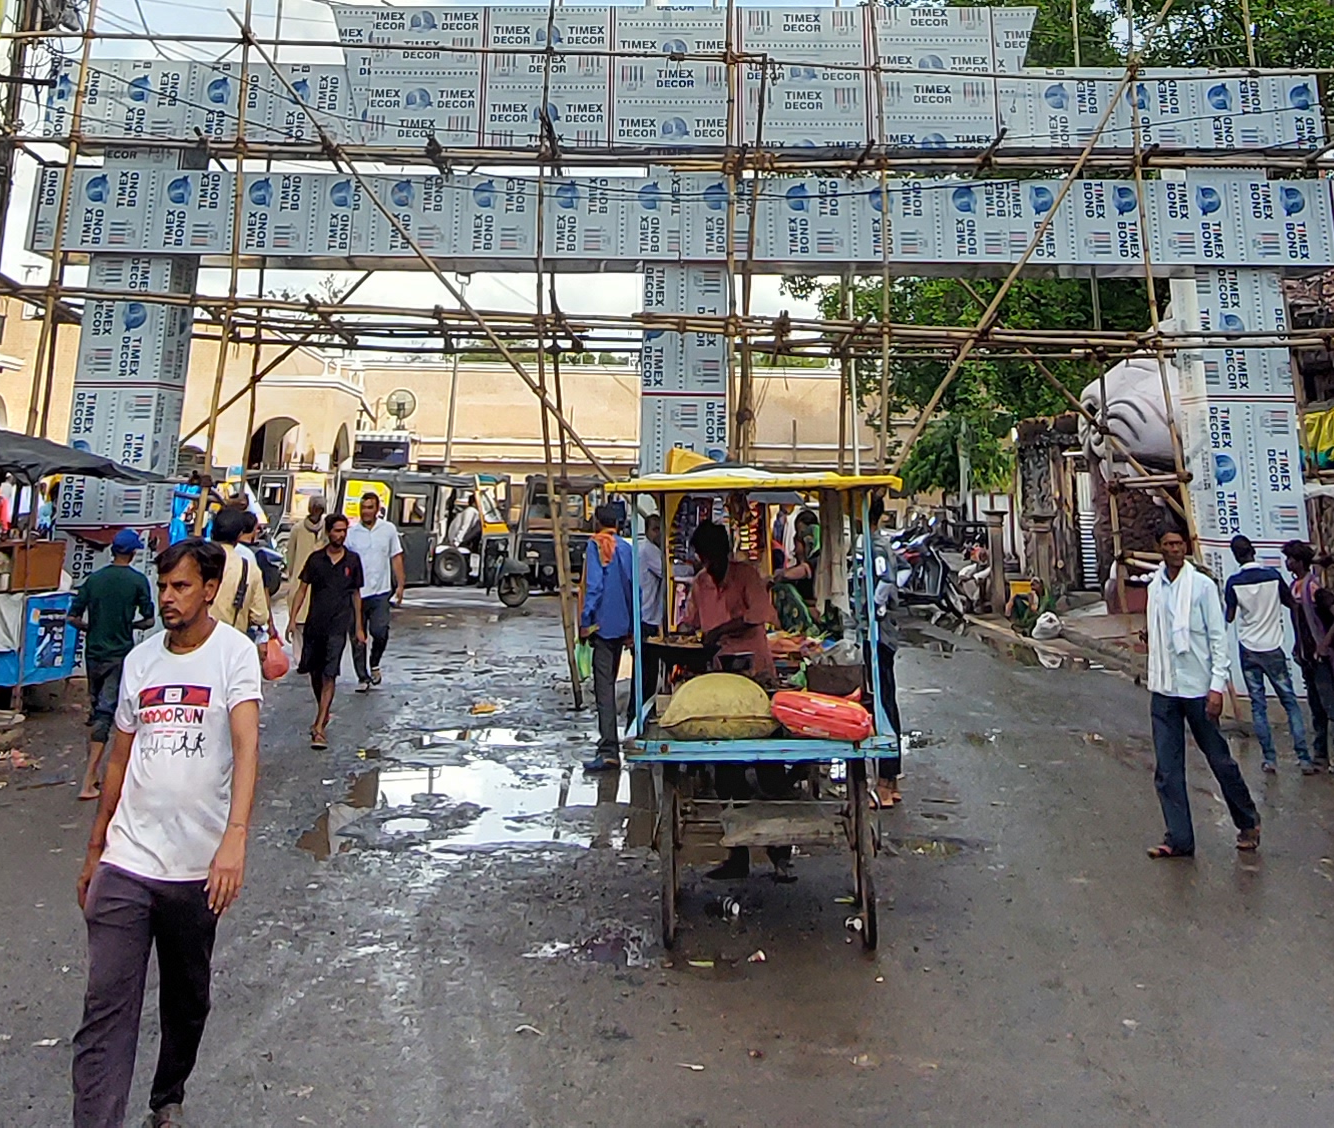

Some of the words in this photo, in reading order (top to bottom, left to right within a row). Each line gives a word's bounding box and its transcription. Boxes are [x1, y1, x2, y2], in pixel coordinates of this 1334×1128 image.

[441, 21, 479, 31] DECOR
[443, 12, 479, 21] TIMEX
[493, 25, 531, 35] TIMEX
[567, 25, 605, 35] TIMEX
[782, 23, 821, 32] DECOR
[783, 13, 821, 23] TIMEX
[910, 8, 948, 17] TIMEX
[910, 18, 949, 27] DECOR
[493, 35, 531, 45] DECOR
[567, 36, 605, 45] DECOR
[620, 39, 657, 49] TIMEX
[657, 69, 694, 78] TIMEX
[950, 56, 988, 65] TIMEX
[317, 74, 330, 111] TIMEX
[328, 76, 339, 111] BOND
[438, 89, 475, 99] TIMEX
[656, 78, 695, 88] DECOR
[784, 91, 822, 100] TIMEX
[913, 85, 951, 94] TIMEX
[913, 95, 952, 104] DECOR
[1157, 80, 1170, 116] TIMEX
[1168, 80, 1180, 114] BOND
[437, 99, 475, 108] DECOR
[490, 103, 528, 113] TIMEX
[490, 113, 528, 122] DECOR
[565, 113, 604, 123] DECOR
[566, 103, 603, 113] TIMEX
[784, 101, 823, 110] DECOR
[398, 119, 436, 129] TIMEX
[618, 118, 657, 128] TIMEX
[618, 128, 657, 138] DECOR
[117, 170, 130, 207] TIMEX
[128, 172, 139, 207] BOND
[198, 172, 210, 209] TIMEX
[209, 174, 220, 209] BOND
[279, 174, 292, 212] TIMEX
[291, 175, 302, 211] BOND
[423, 175, 434, 213] TIMEX
[433, 177, 444, 212] BOND
[505, 178, 517, 214] TIMEX
[516, 179, 526, 213] BOND
[1012, 181, 1024, 219] TIMEX
[1083, 182, 1095, 219] BOND
[1094, 181, 1106, 219] TIMEX
[1167, 182, 1179, 219] BOND
[1177, 181, 1189, 220] TIMEX
[1250, 183, 1262, 219] BOND
[1260, 182, 1274, 220] TIMEX
[80, 207, 93, 245] TIMEX
[91, 208, 105, 245] BOND
[328, 212, 340, 251] TIMEX
[338, 213, 350, 251] BOND
[472, 213, 484, 251] TIMEX
[483, 214, 494, 251] BOND
[555, 214, 567, 253] TIMEX
[567, 215, 577, 252] BOND
[639, 215, 650, 254] TIMEX
[650, 216, 660, 253] BOND
[704, 216, 715, 255] TIMEX
[715, 217, 725, 254] BOND
[788, 217, 799, 256] TIMEX
[799, 218, 810, 255] BOND
[956, 218, 967, 257] TIMEX
[967, 219, 978, 256] BOND
[1117, 221, 1130, 258] BOND
[1127, 221, 1140, 259] TIMEX
[1286, 222, 1298, 260] BOND
[1296, 221, 1310, 260] TIMEX
[645, 267, 654, 306] DECOR
[655, 267, 665, 306] TIMEX
[118, 336, 131, 377] DECOR
[129, 336, 142, 376] TIMEX
[643, 346, 653, 387] DECOR
[654, 346, 663, 387] TIMEX
[1225, 348, 1237, 390] DECOR
[1236, 349, 1250, 390] TIMEX
[72, 393, 85, 434] DECOR
[83, 393, 96, 433] TIMEX
[706, 401, 715, 444] DECOR
[717, 402, 726, 443] TIMEX
[1267, 448, 1279, 493] DECOR
[1278, 449, 1292, 491] TIMEX
[1216, 490, 1229, 535] DECOR
[1227, 491, 1241, 534] TIMEX
